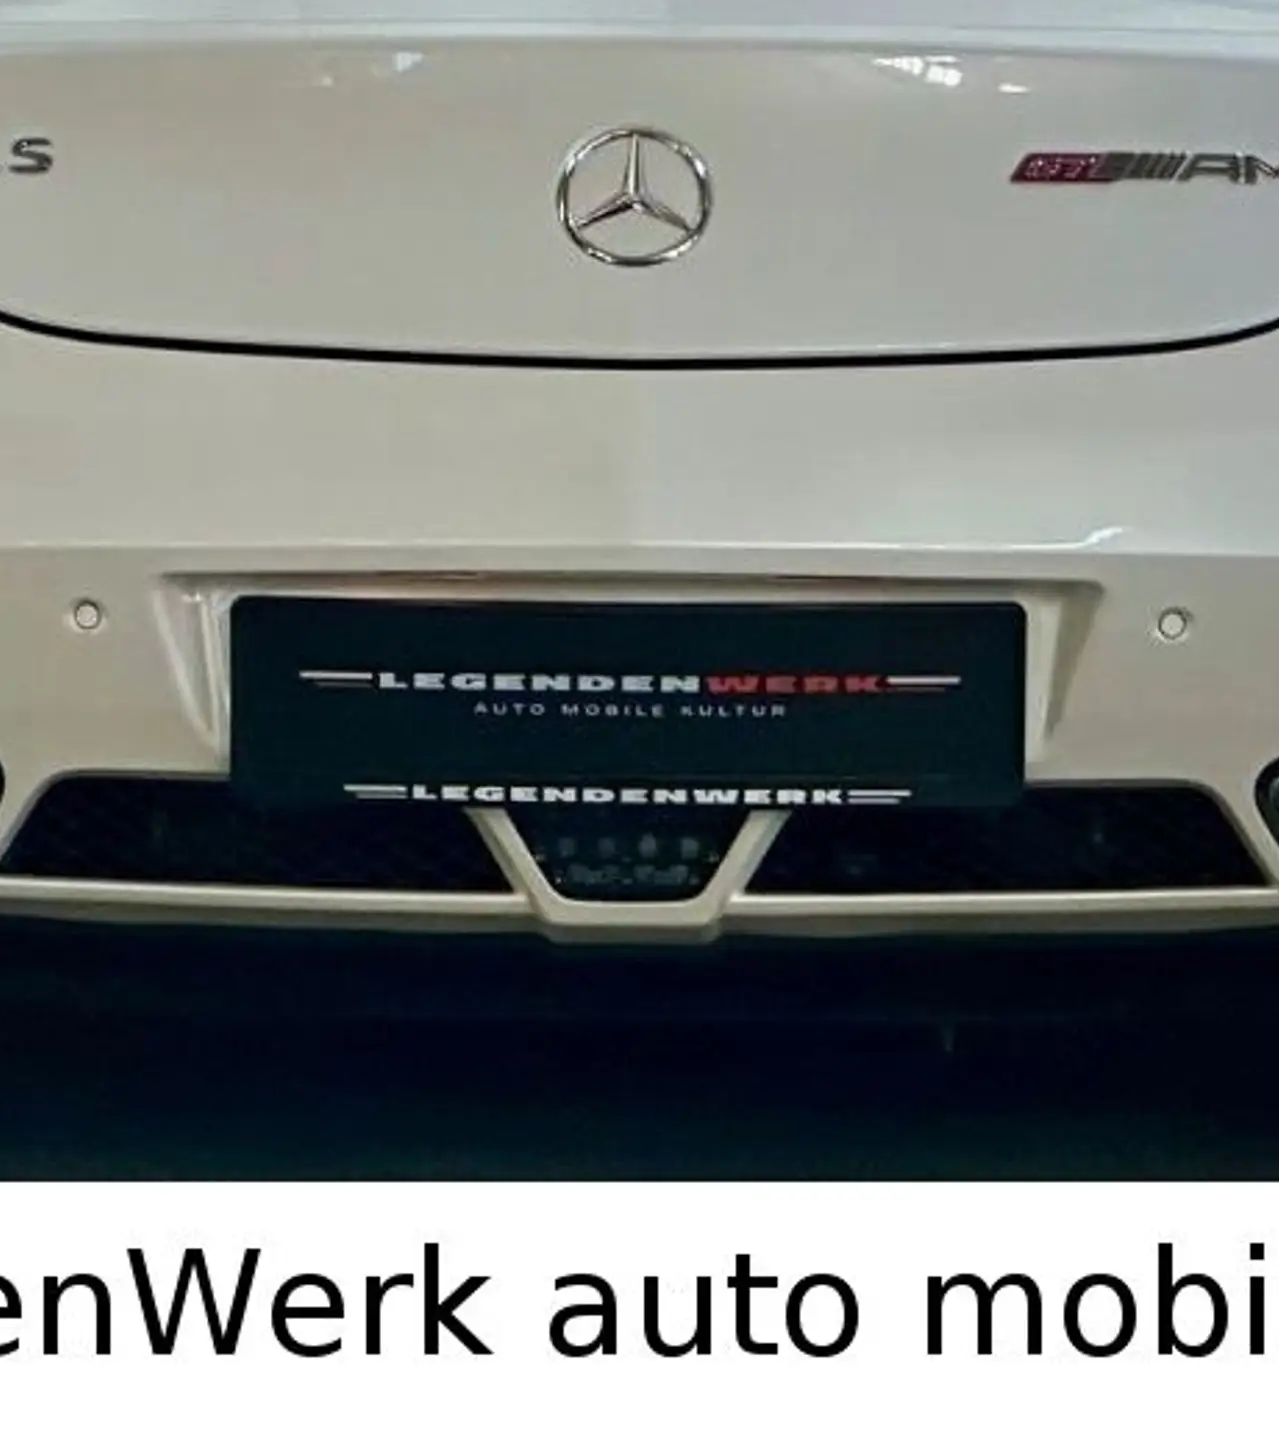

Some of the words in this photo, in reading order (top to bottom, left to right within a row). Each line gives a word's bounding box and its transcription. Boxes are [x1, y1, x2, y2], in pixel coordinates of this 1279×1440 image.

[379, 672, 882, 693] LEGENDENWERK
[474, 701, 546, 717] AUTO
[561, 702, 665, 718] MOBILE
[679, 703, 787, 718] KULTUR
[413, 784, 842, 805] LEGENDENWERK
